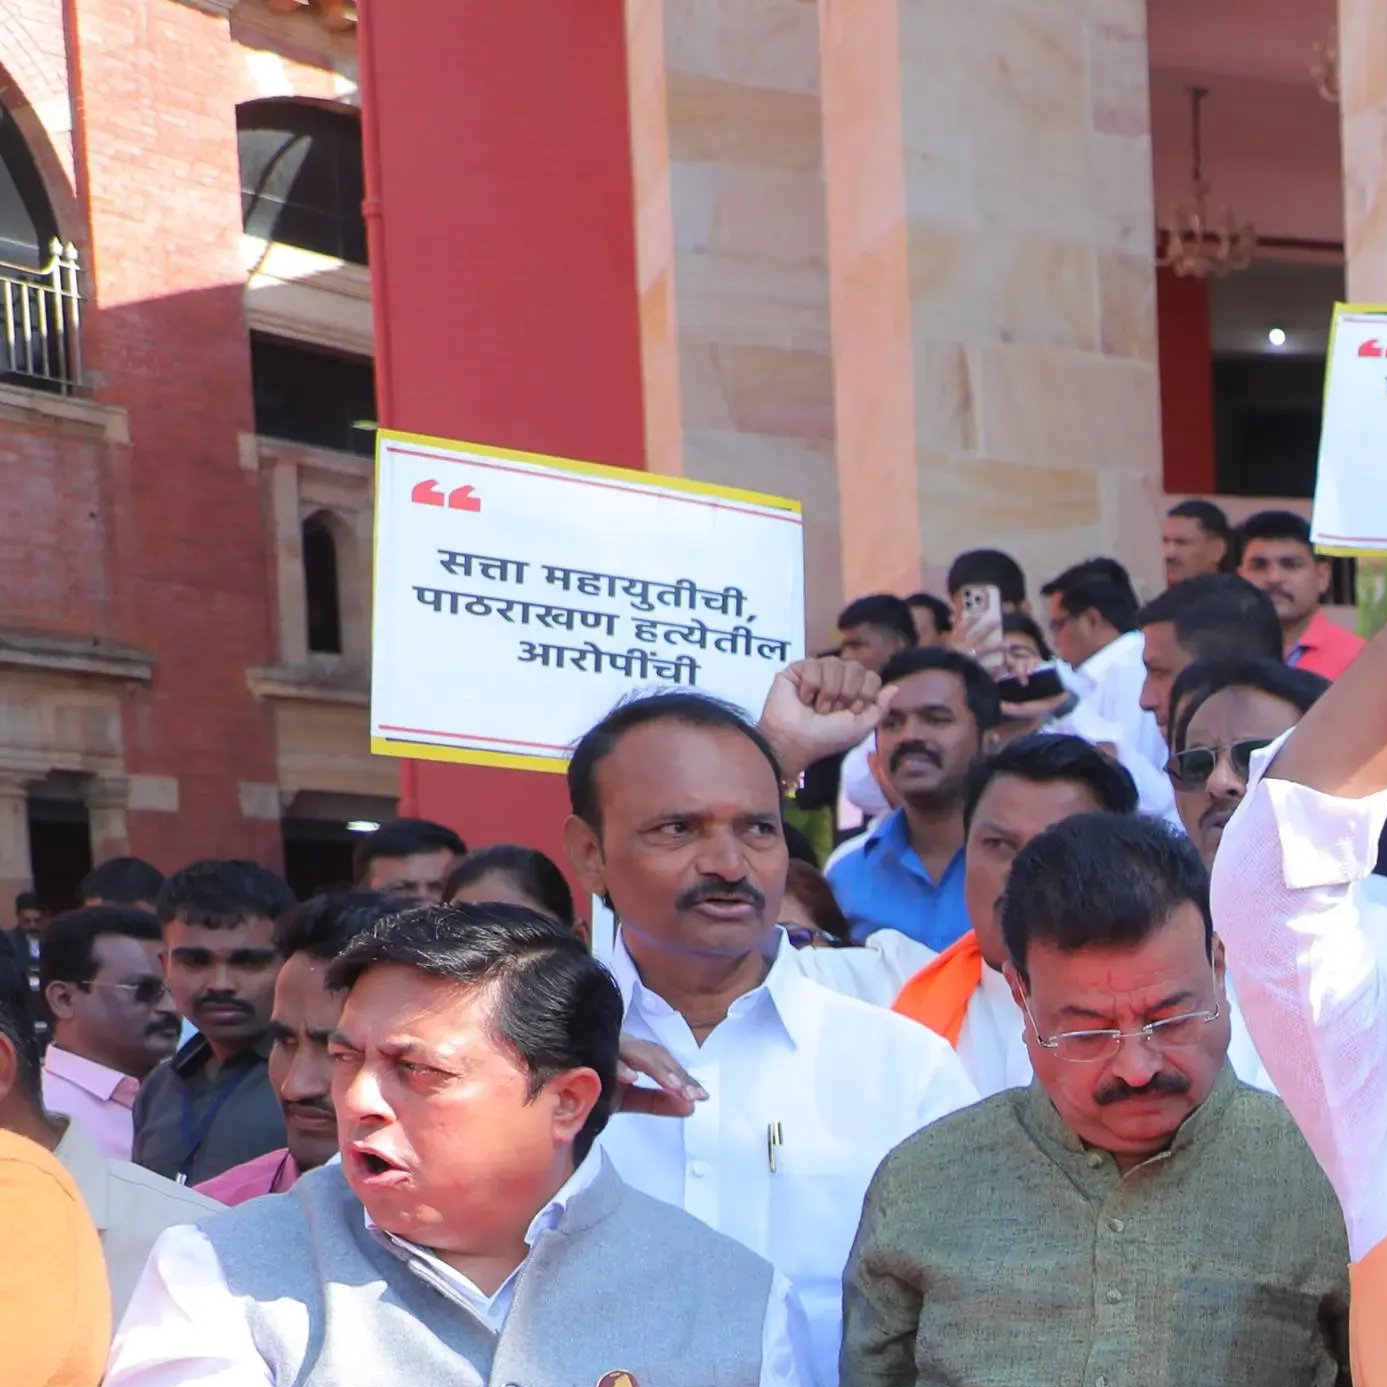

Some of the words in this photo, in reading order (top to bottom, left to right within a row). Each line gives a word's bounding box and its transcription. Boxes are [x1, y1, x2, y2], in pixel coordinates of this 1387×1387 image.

[437, 548, 530, 584] सत्ता
[412, 585, 621, 636] पाठराखण
[631, 616, 792, 662] हत्येतील
